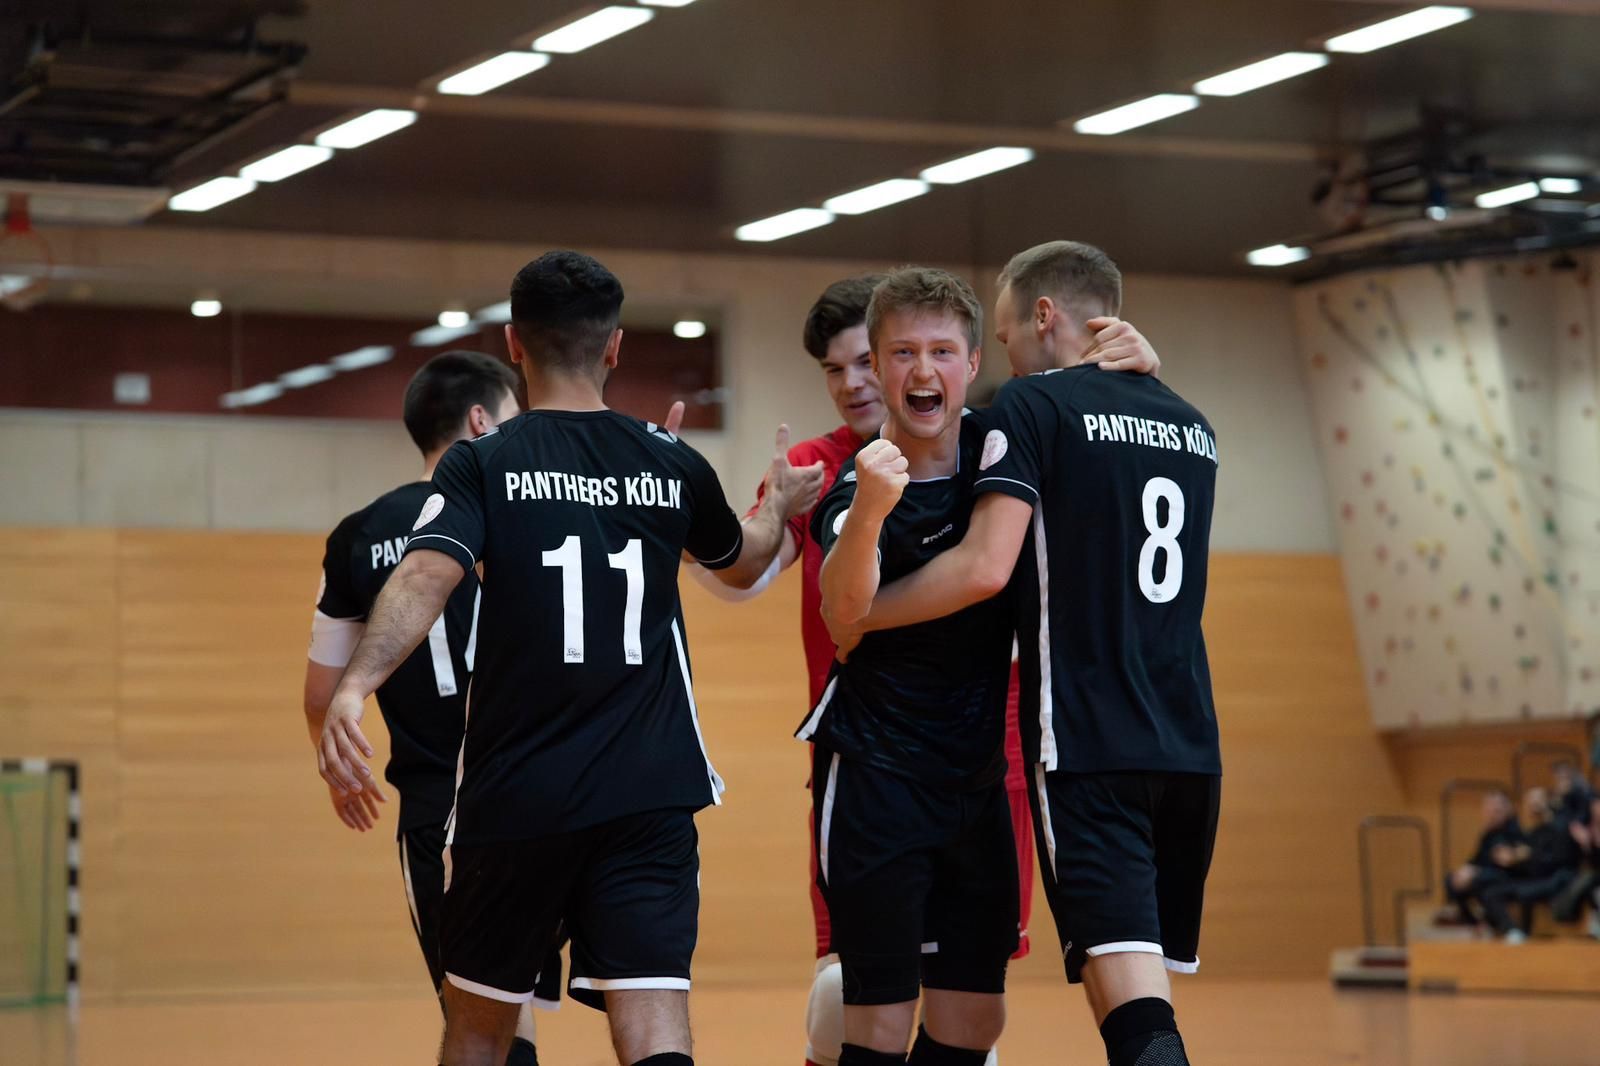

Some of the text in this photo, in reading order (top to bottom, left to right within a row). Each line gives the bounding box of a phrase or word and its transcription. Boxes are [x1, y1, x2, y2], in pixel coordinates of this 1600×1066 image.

[1083, 414, 1182, 451] PANTHERS
[505, 471, 682, 510] PANTHERS KÖLN
[1138, 476, 1185, 604] 8
[541, 535, 645, 665] 11
